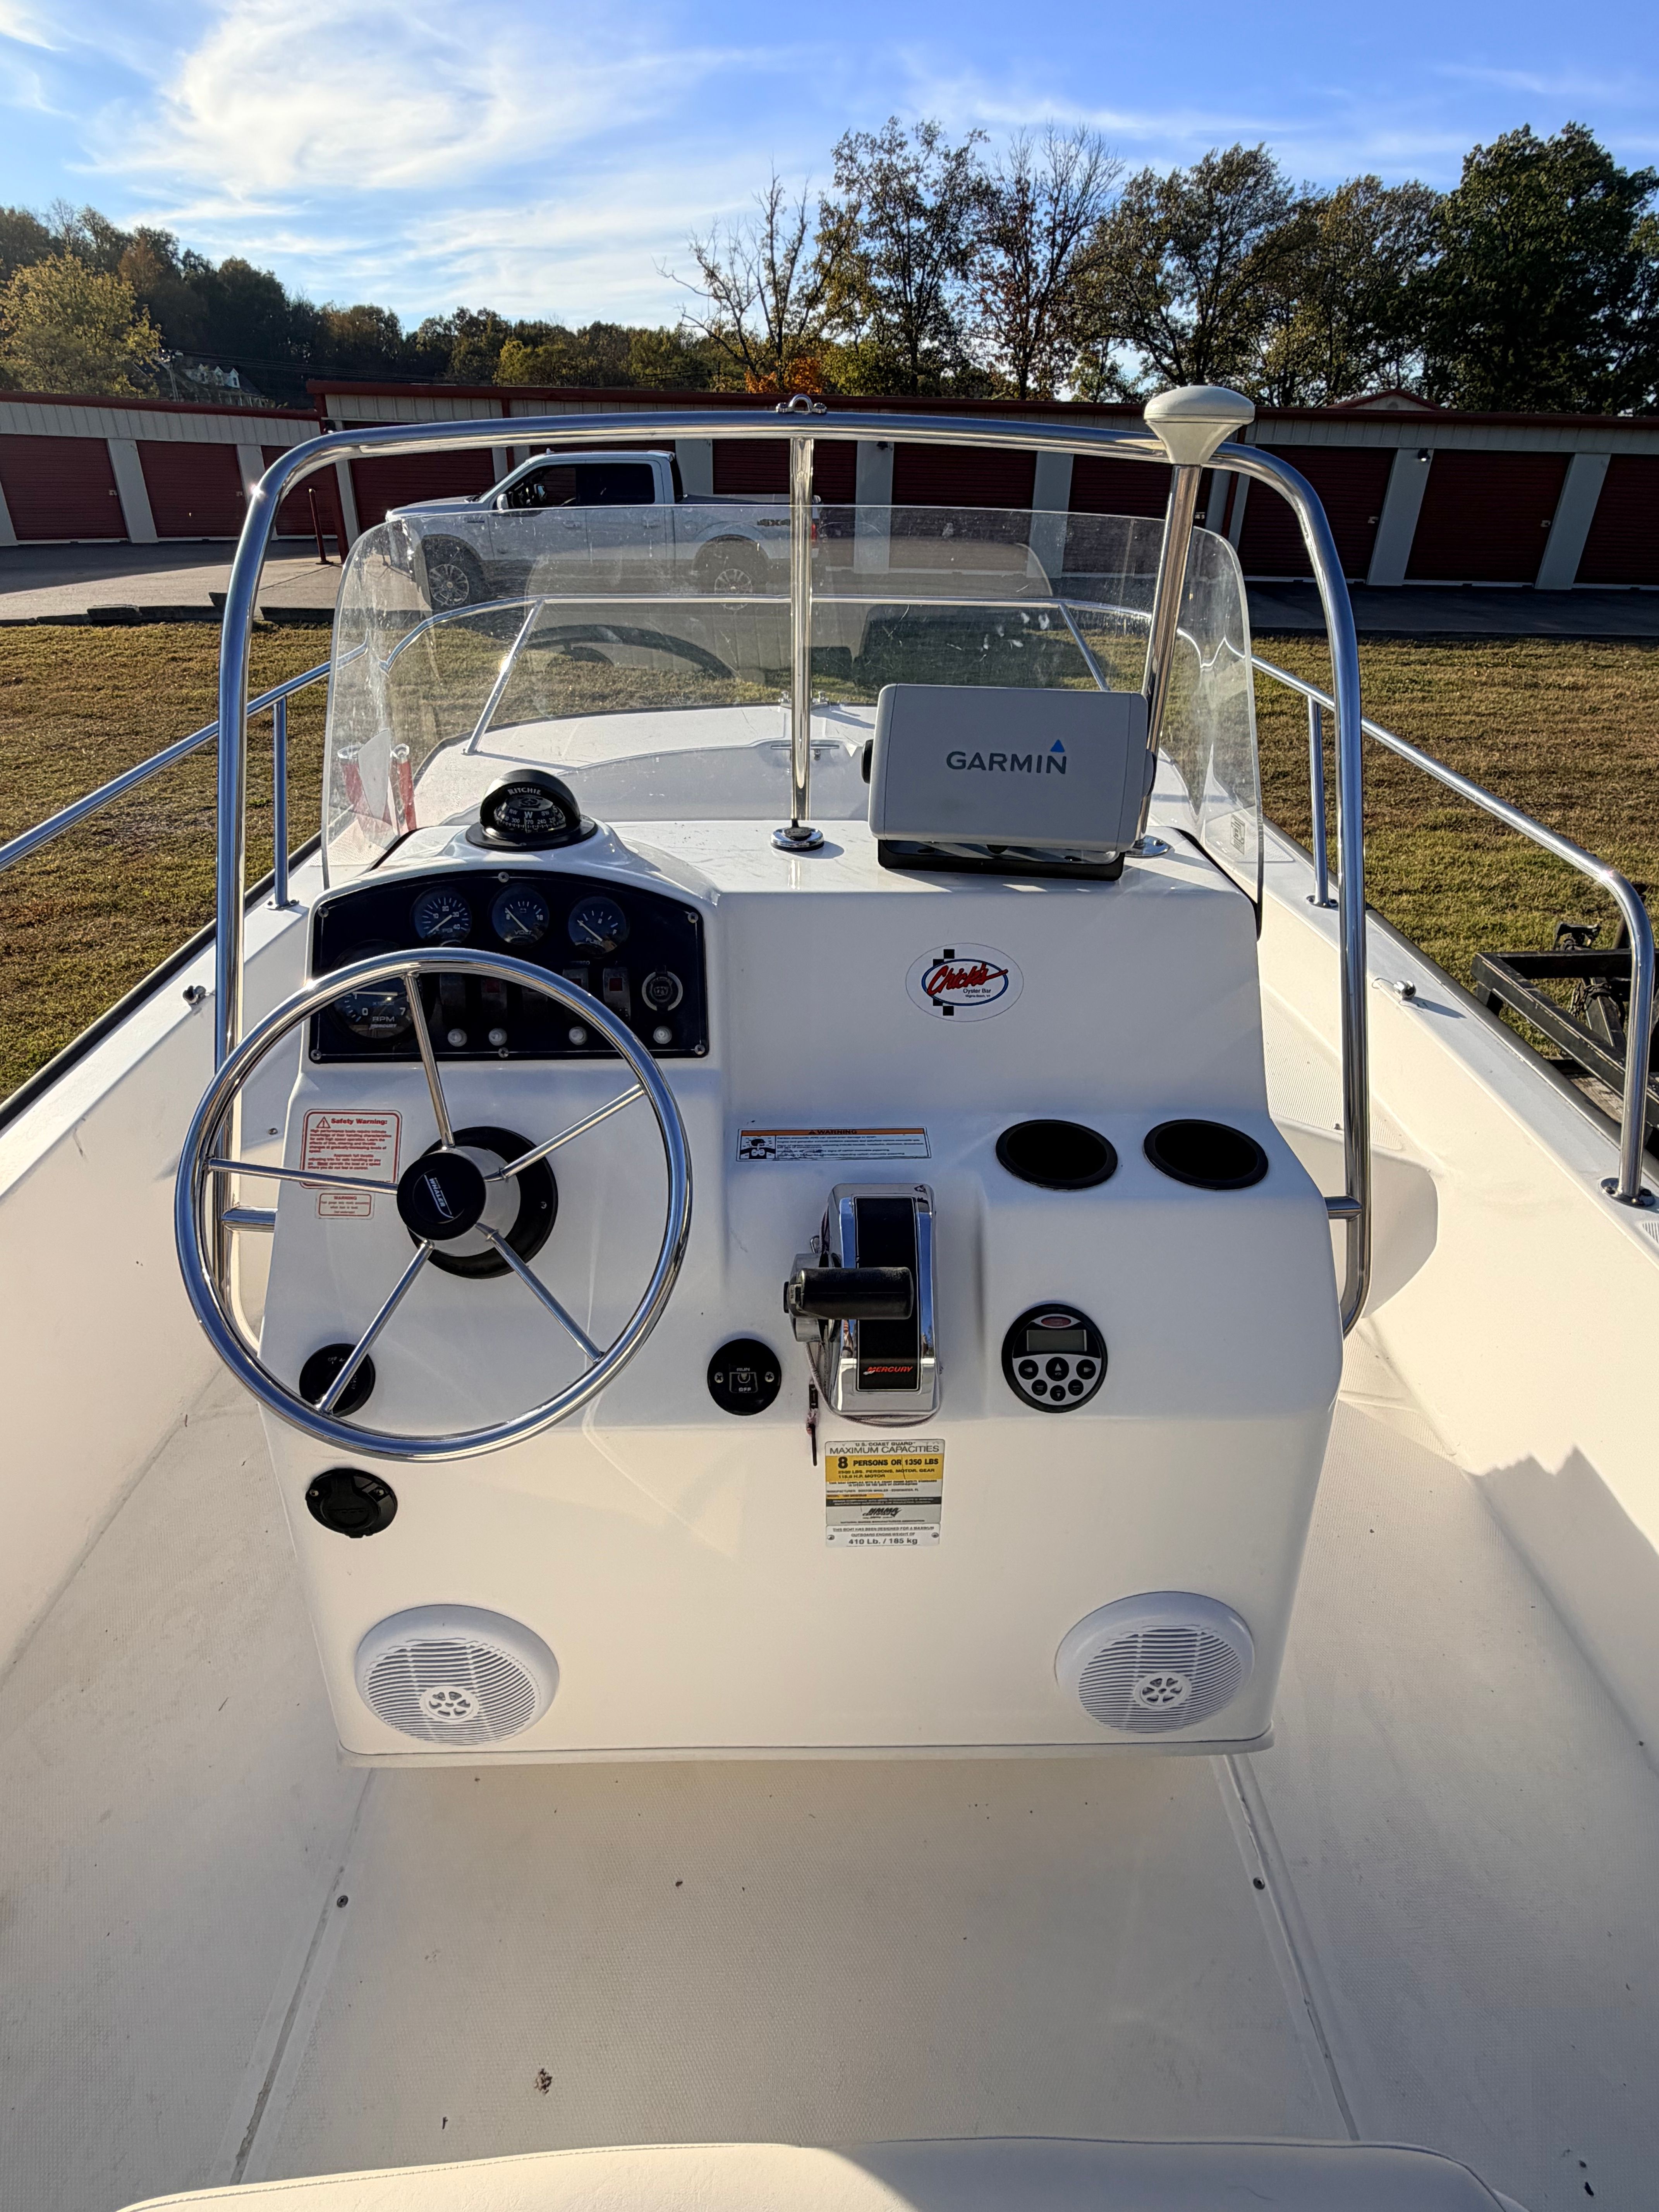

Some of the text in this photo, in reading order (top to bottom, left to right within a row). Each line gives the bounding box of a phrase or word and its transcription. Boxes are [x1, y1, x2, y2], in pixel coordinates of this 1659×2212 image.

[946, 751, 1066, 775] GARMIN
[362, 1007, 406, 1016] 0 7
[429, 1178, 446, 1207] WHALER
[838, 1456, 848, 1469] 8
